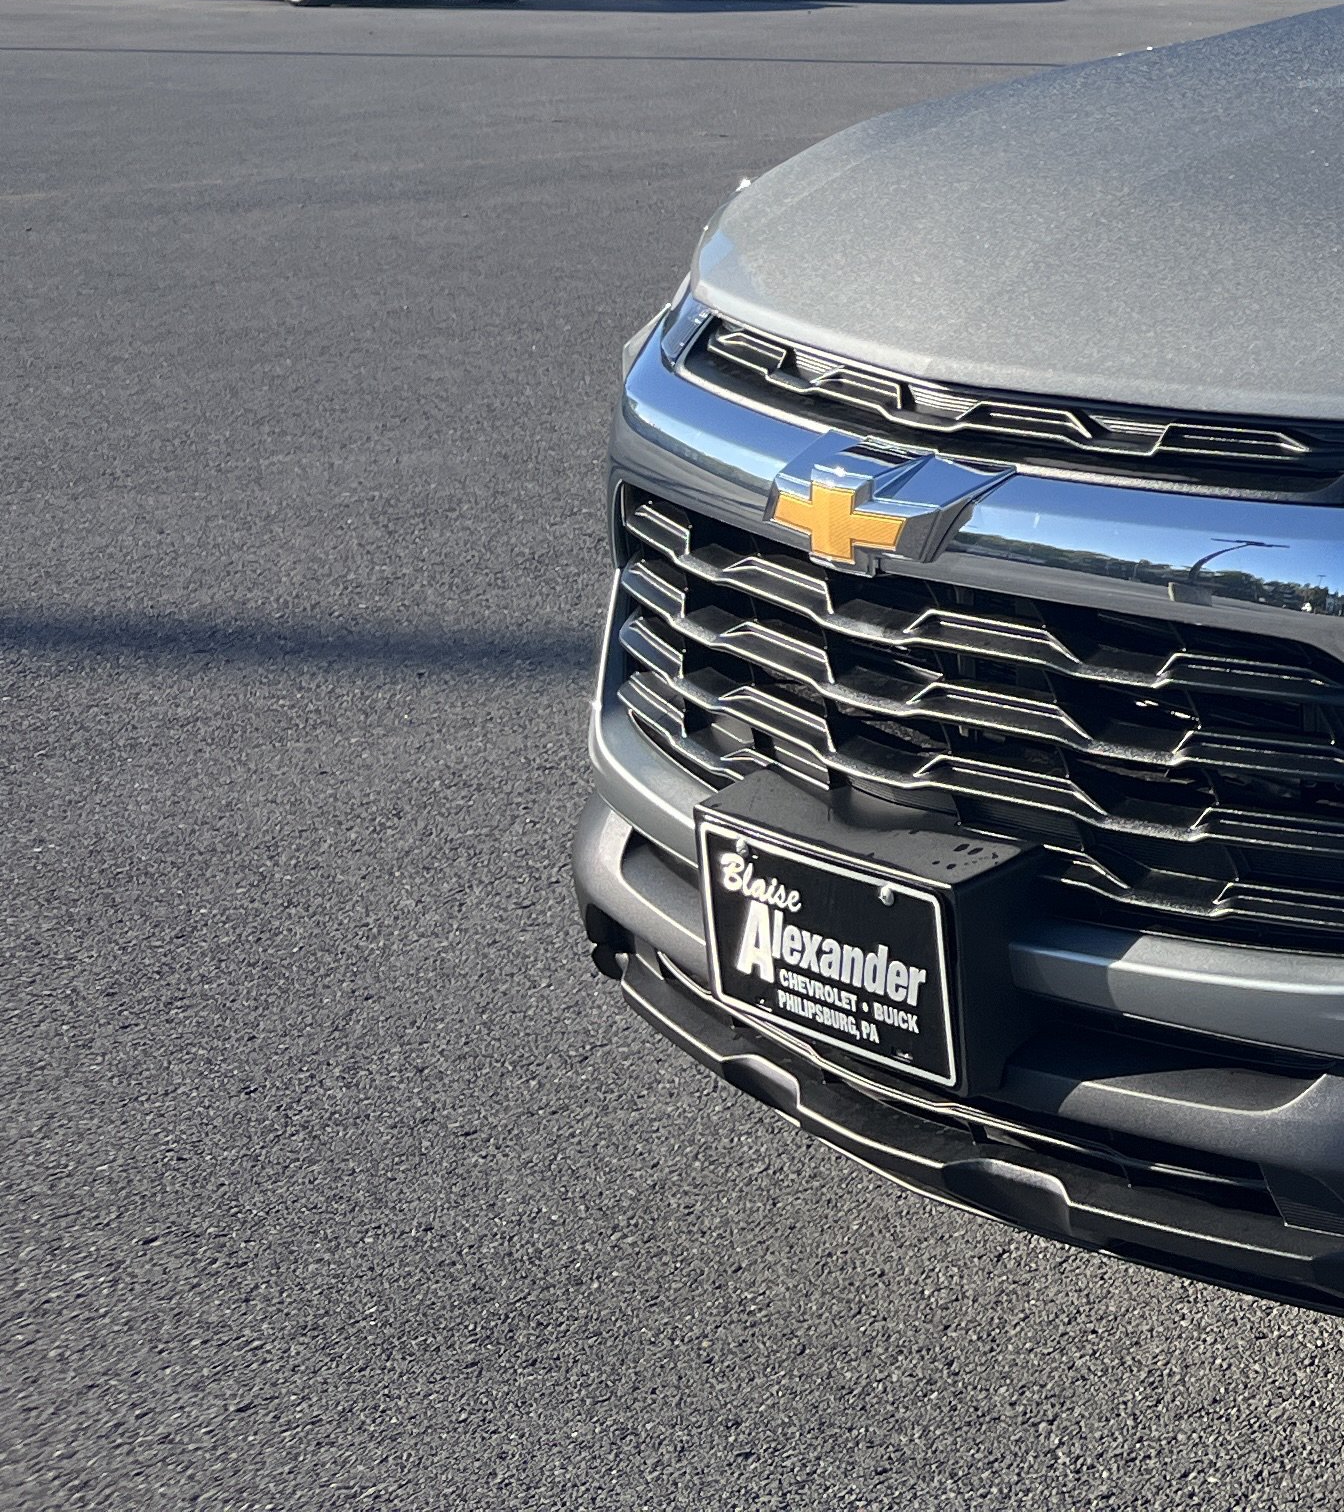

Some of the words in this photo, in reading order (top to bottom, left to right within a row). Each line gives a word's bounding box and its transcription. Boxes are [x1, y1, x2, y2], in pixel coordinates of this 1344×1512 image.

[719, 852, 802, 912] Blaise
[736, 900, 927, 1007] Alexander
[777, 989, 860, 1041] PHILIPSBURG,
[861, 1020, 880, 1044] PA
[779, 968, 858, 1013] CHEVROLET
[873, 1001, 920, 1034] BUICK
